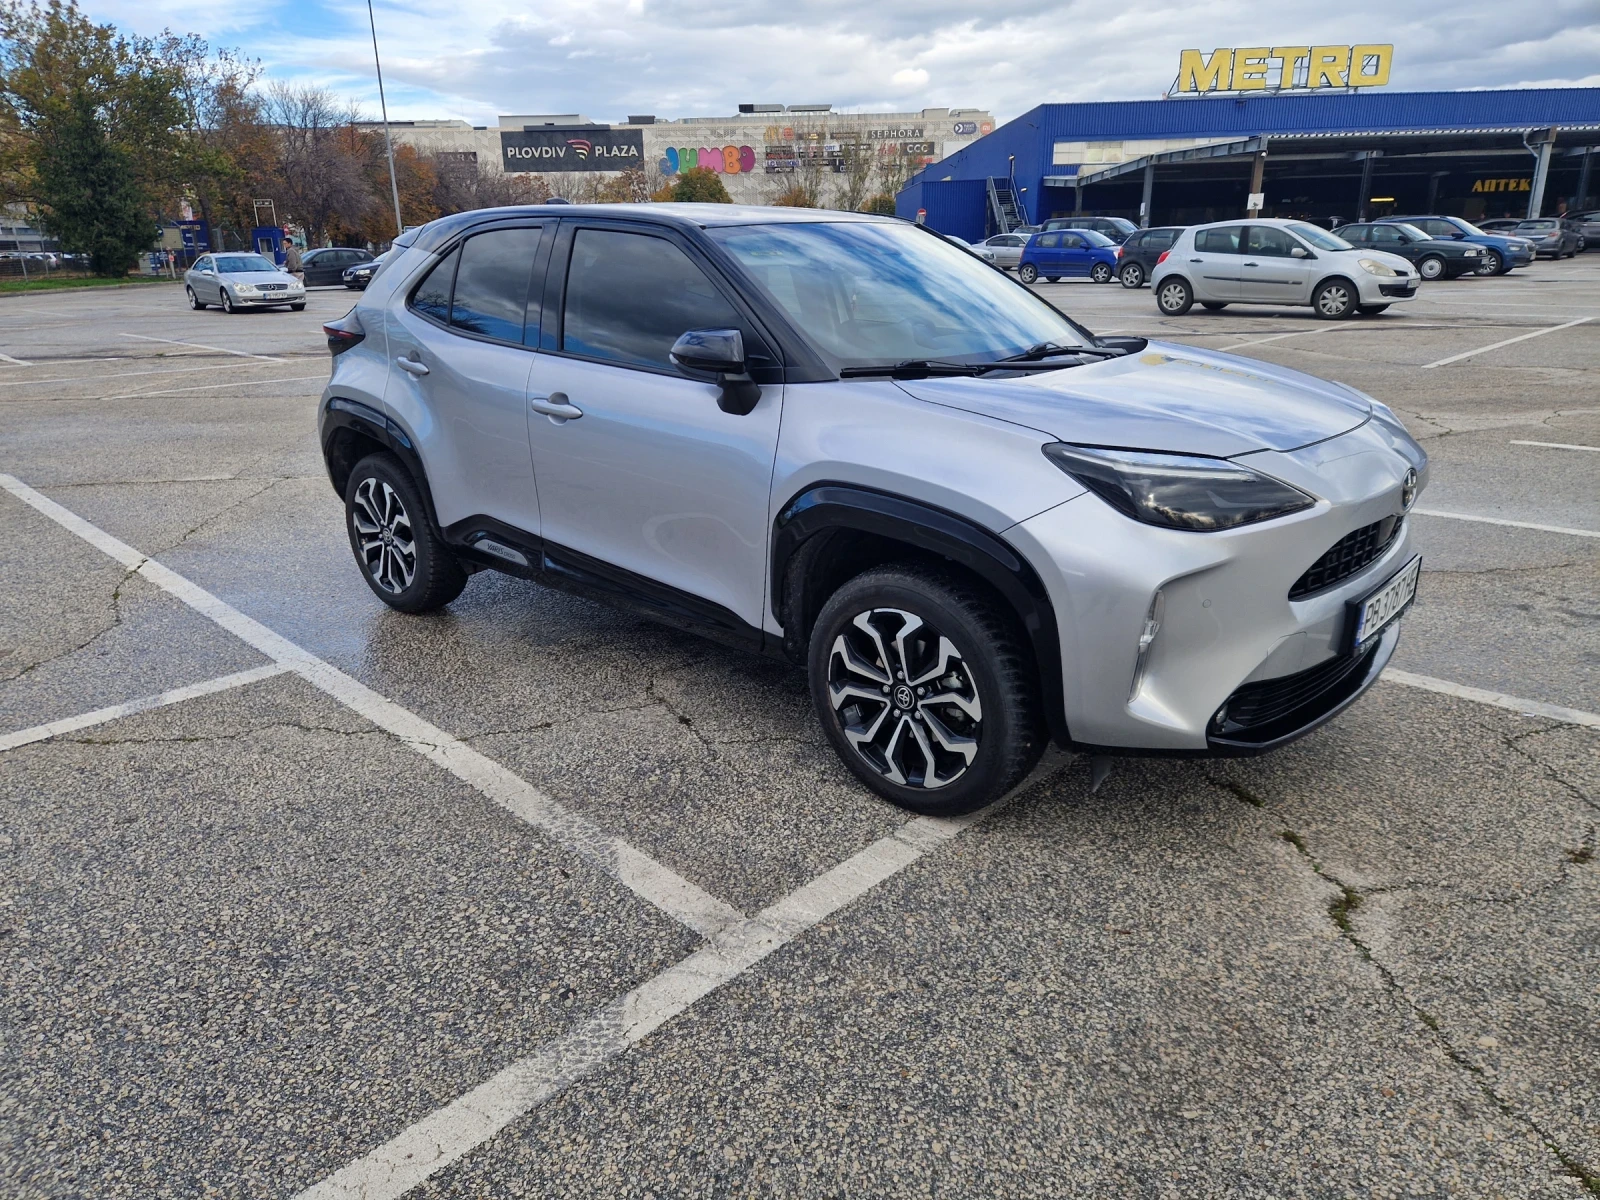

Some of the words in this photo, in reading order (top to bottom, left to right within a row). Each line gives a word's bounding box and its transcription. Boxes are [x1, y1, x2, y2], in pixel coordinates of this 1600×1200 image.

[1178, 44, 1393, 92] METRO
[871, 129, 921, 139] SEPHORA
[507, 146, 567, 159] PLOVDIV
[595, 145, 639, 157] PLAZA
[906, 144, 929, 153] CCC
[439, 153, 476, 162] ZARA
[658, 145, 756, 175] JUMBO
[1363, 598, 1380, 635] PB
